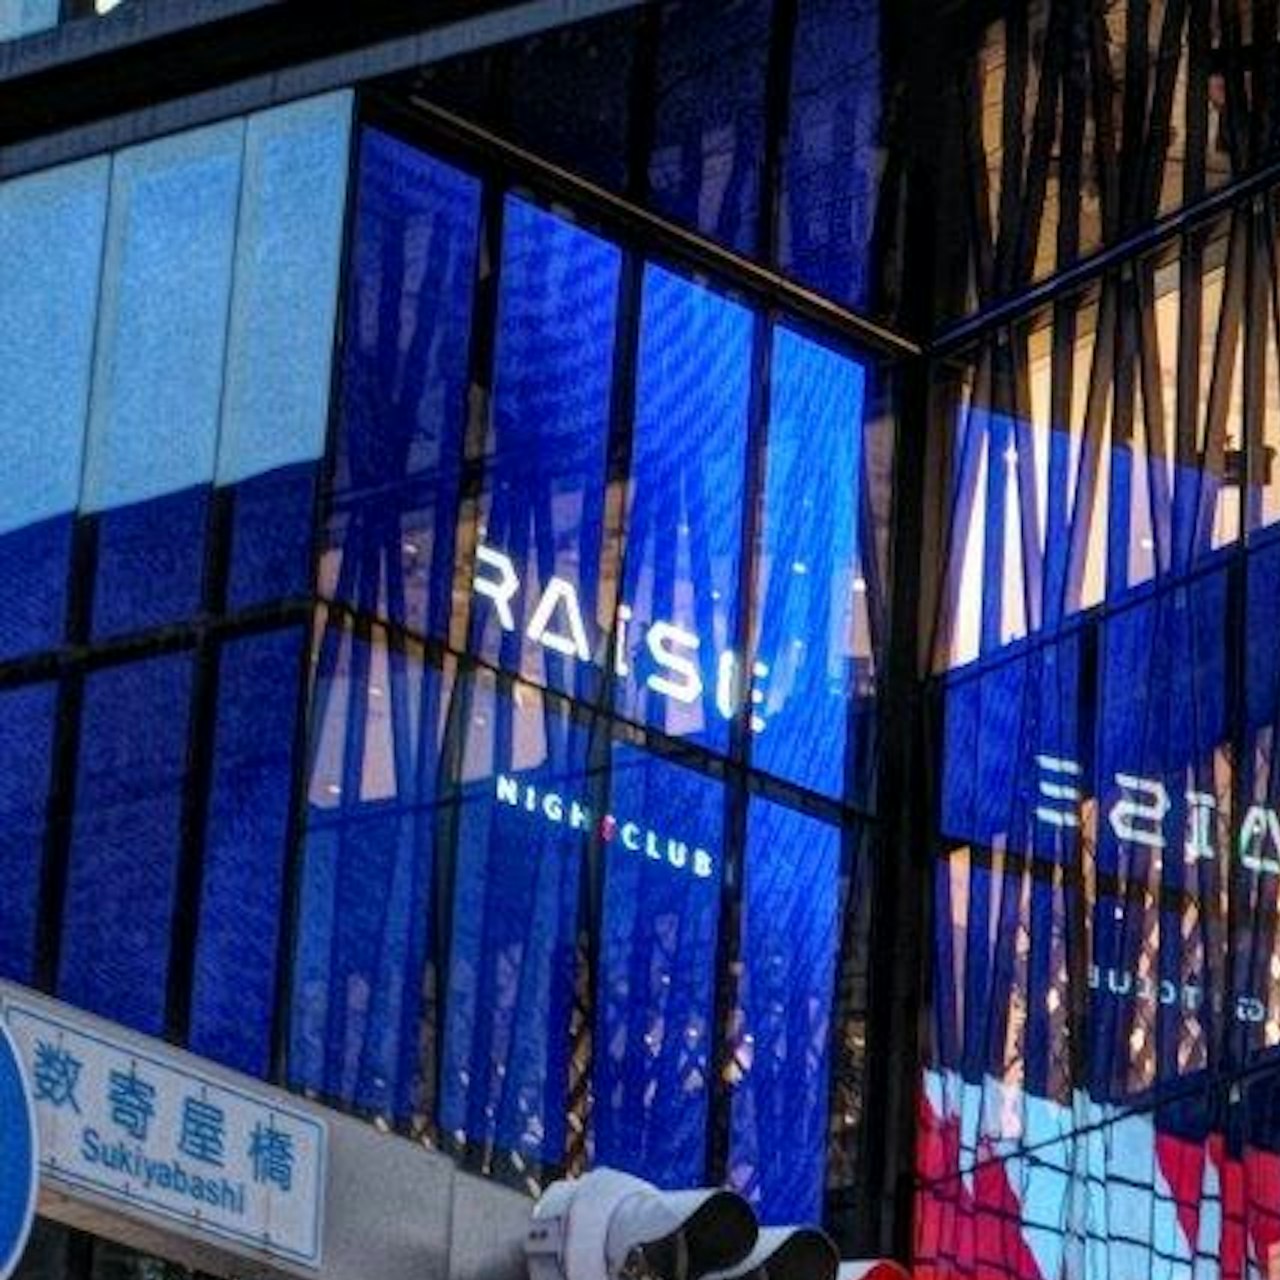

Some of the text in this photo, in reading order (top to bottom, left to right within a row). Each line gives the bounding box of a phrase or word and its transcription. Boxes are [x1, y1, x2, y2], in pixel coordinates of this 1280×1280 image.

[33, 1032, 295, 1192] 数寄屋橋
[80, 1126, 246, 1215] Sukiyabashi
